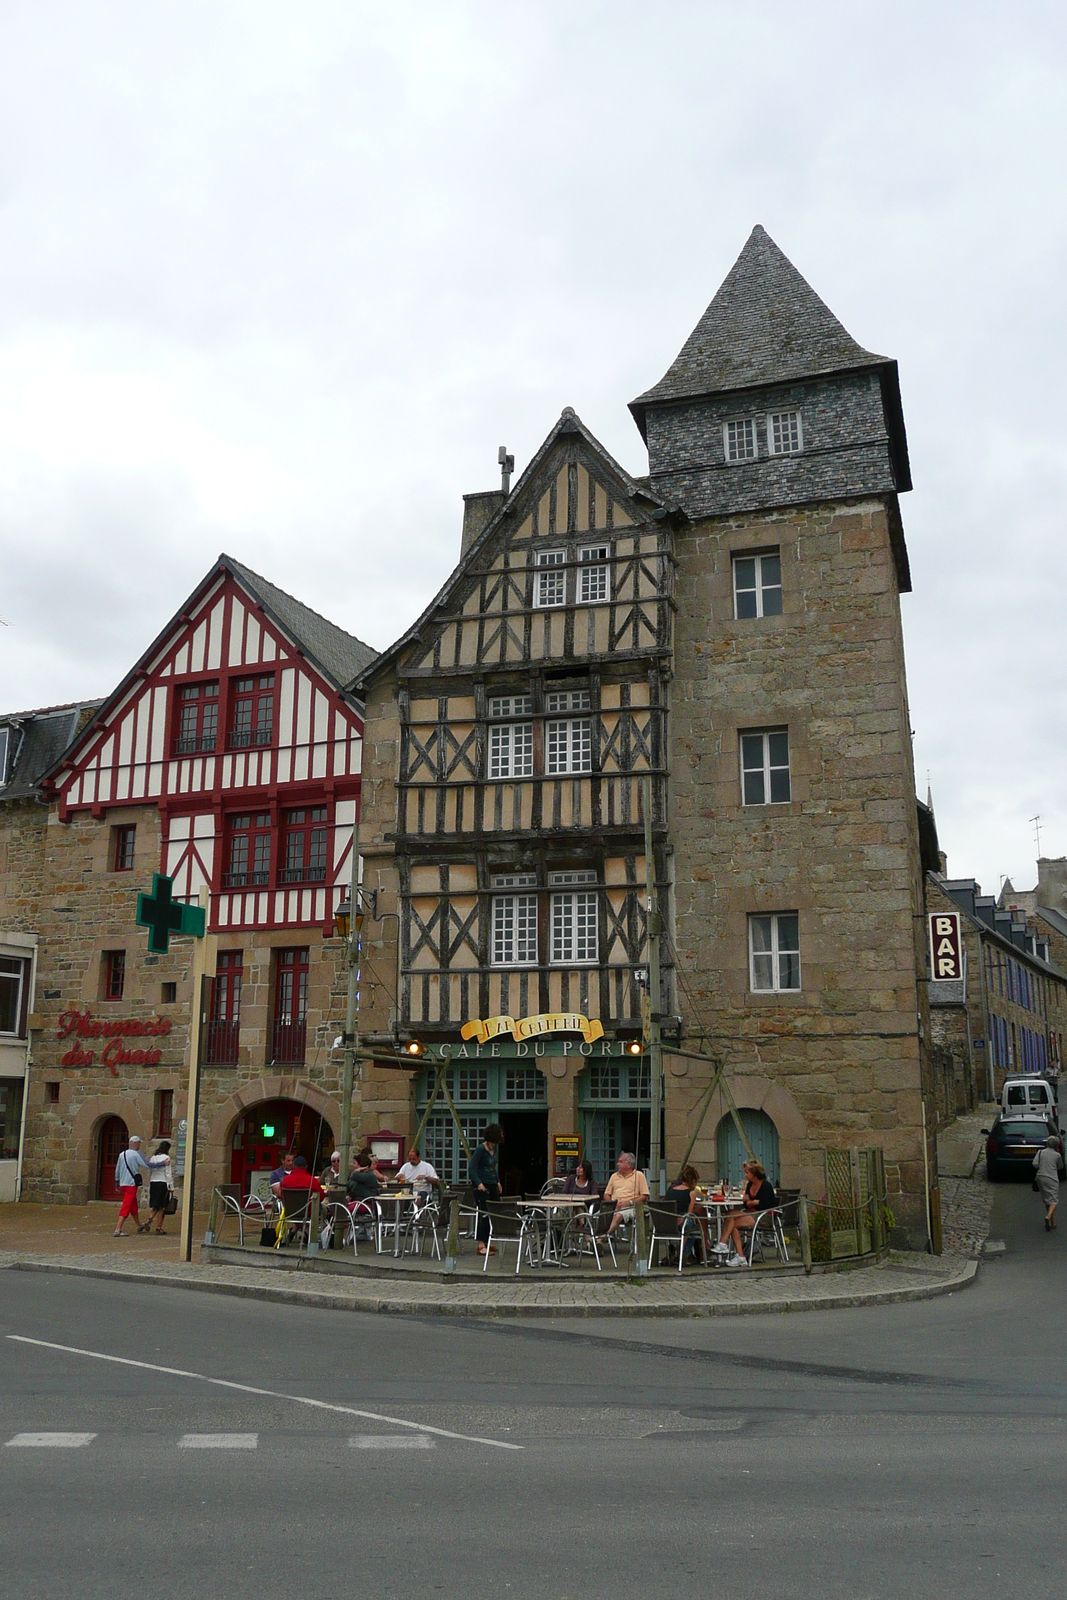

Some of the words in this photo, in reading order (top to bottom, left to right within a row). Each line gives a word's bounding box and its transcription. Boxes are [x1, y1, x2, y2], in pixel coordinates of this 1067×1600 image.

[935, 917, 956, 977] BAR
[57, 1010, 171, 1039] Pharmacie
[485, 1020, 515, 1037] BAR
[61, 1040, 94, 1066] des
[101, 1037, 162, 1076] Quais
[439, 1043, 501, 1058] CAFE
[516, 1042, 545, 1057] DU
[563, 1040, 628, 1056] PORT
